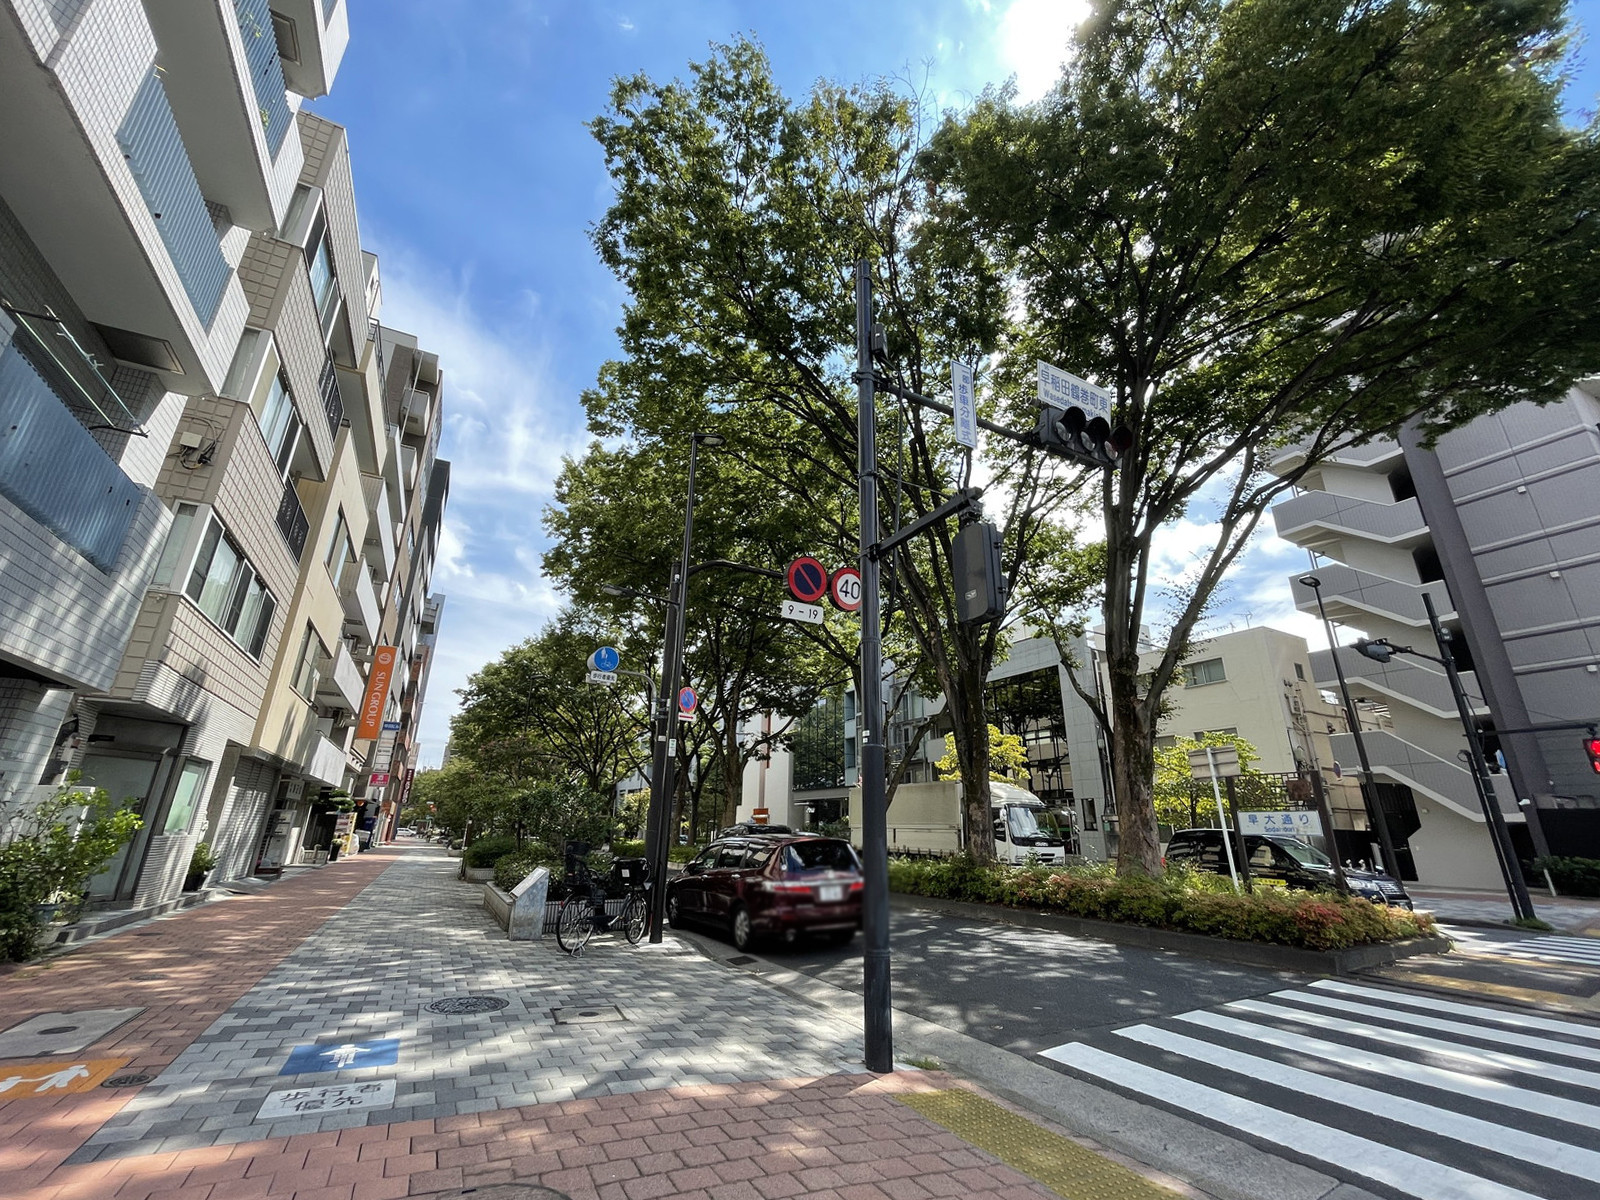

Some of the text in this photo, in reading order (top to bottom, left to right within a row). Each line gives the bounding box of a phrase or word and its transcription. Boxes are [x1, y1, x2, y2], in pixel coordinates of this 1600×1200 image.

[1040, 369, 1108, 414] 早稲田鶴巻町東
[839, 579, 861, 600] 40
[366, 671, 387, 727] SUN GROUP
[1248, 813, 1309, 825] 早大通り
[280, 1083, 384, 1102] 歩行者
